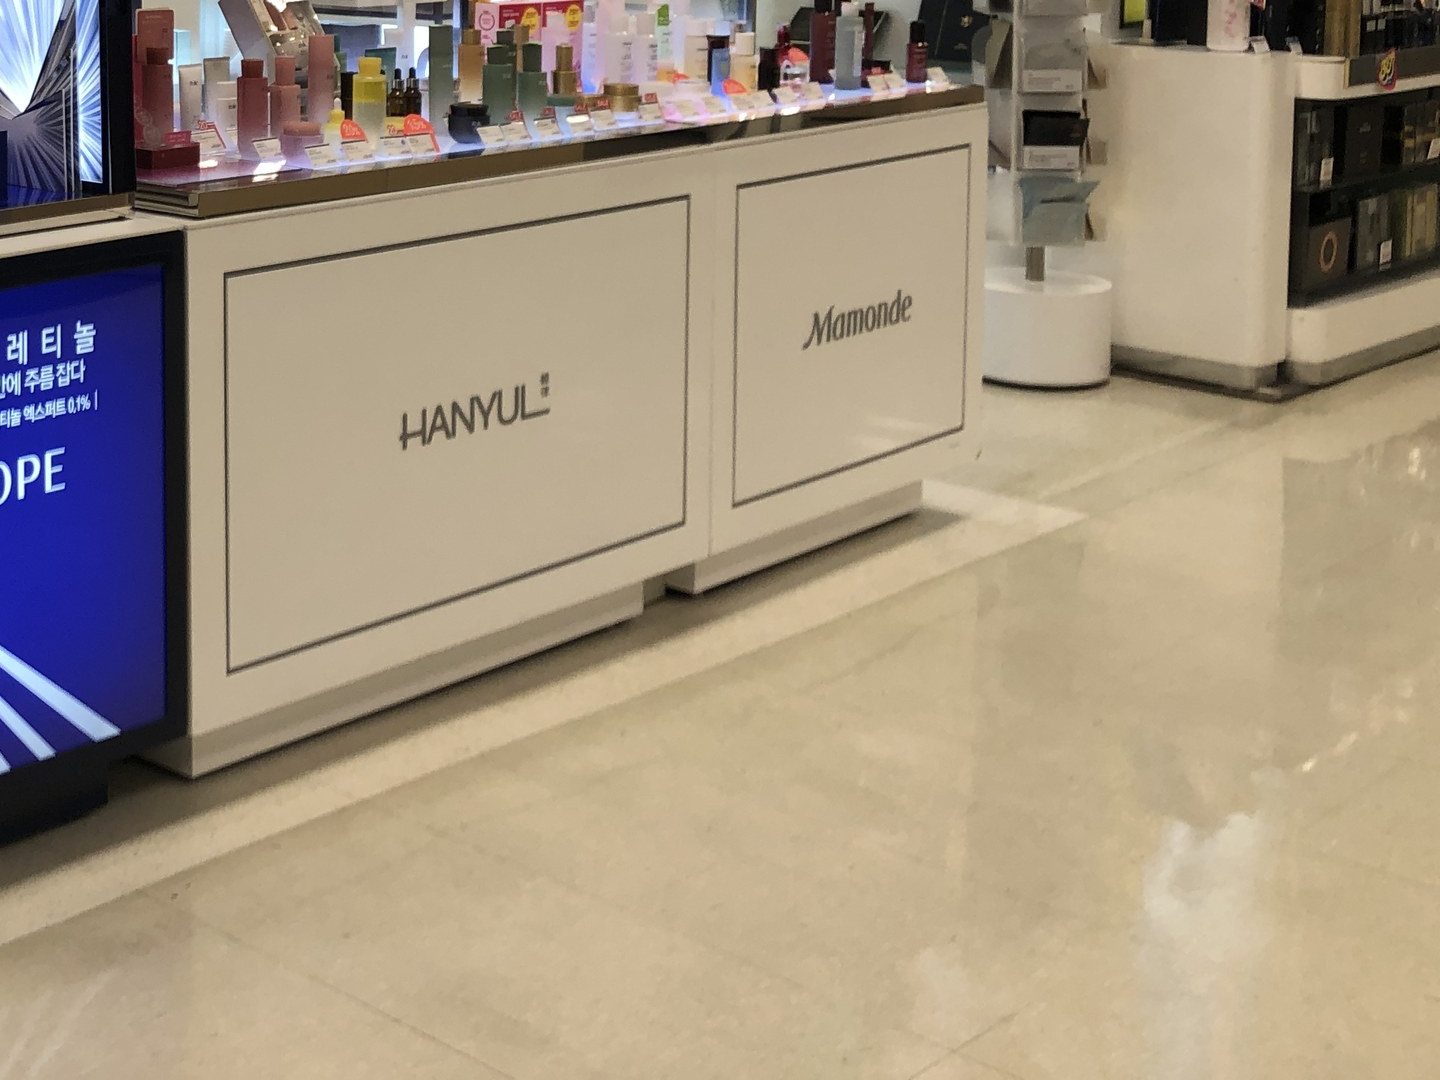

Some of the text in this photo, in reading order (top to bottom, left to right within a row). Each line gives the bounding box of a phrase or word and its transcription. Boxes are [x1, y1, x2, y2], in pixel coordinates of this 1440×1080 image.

[801, 289, 913, 351] Mamonde
[24, 364, 55, 394] 주름
[56, 357, 86, 388] 잡다
[23, 396, 67, 423] 엑스퍼트
[399, 375, 550, 451] HANYUL
